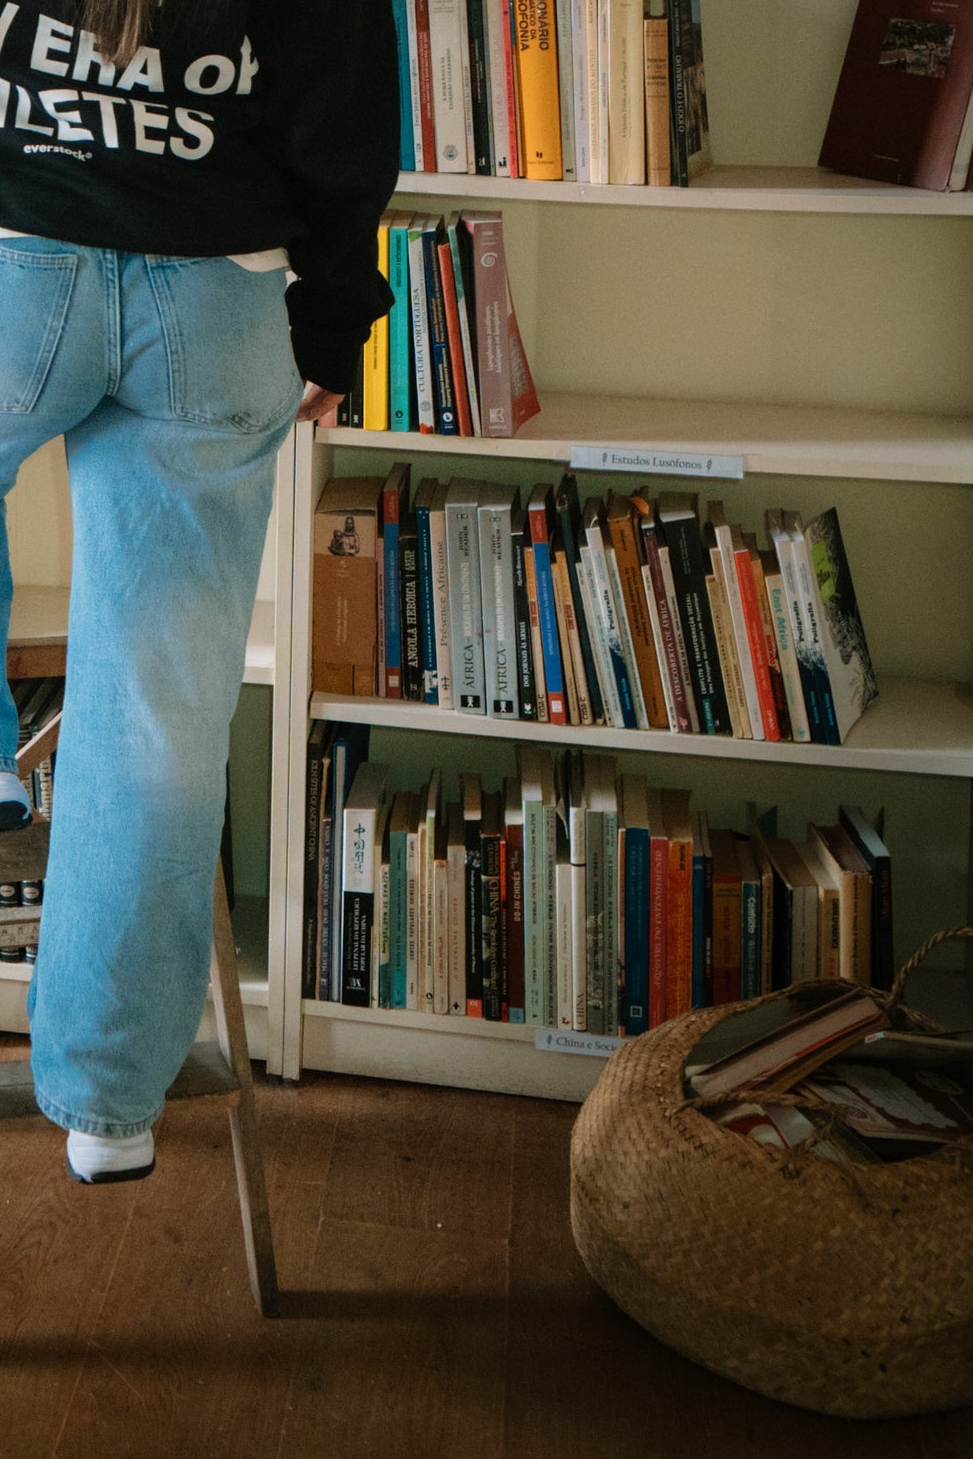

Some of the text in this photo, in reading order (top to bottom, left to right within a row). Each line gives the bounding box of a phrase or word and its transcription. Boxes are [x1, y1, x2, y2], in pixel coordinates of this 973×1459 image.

[530, 29, 536, 40] DA
[412, 287, 425, 393] CULTURA PORTUGUESA
[611, 454, 702, 470] Estudos Lusófonos
[436, 541, 449, 647] Présence Africaine
[658, 599, 672, 630] ÁFRICA
[405, 580, 418, 669] ANGOLA HERÓICA
[664, 631, 674, 641] DE
[462, 643, 476, 690] ÁFRICA
[495, 648, 508, 694] ÁFRICA
[666, 642, 683, 696] DESCOBERTA
[556, 1035, 586, 1049] China
